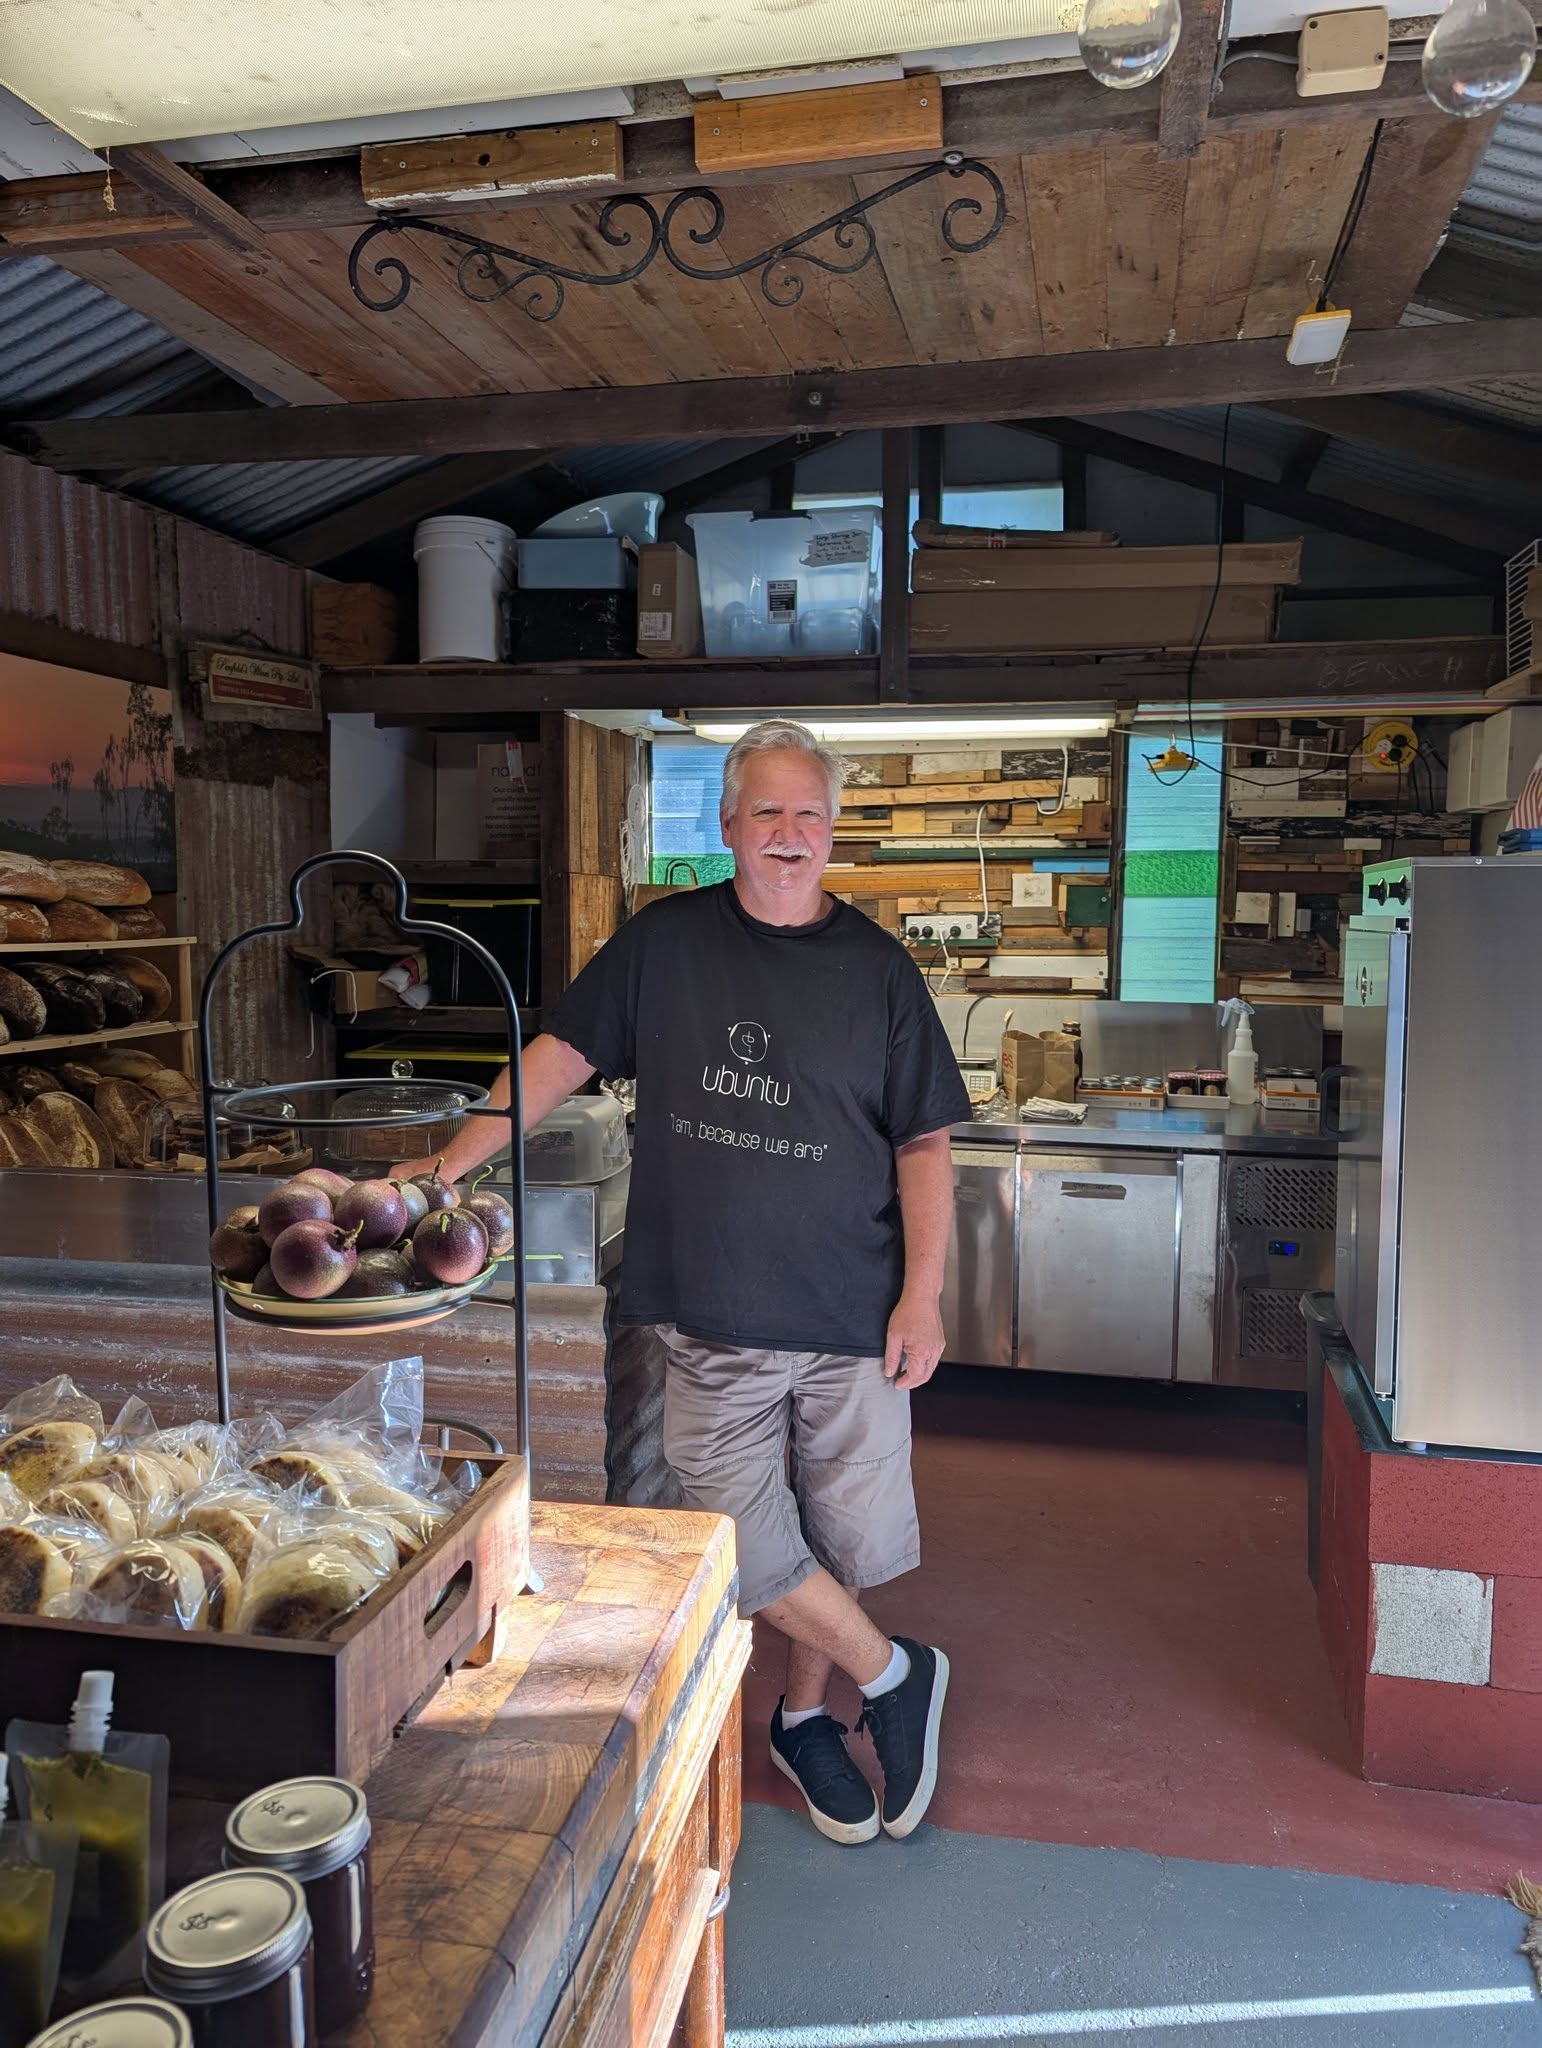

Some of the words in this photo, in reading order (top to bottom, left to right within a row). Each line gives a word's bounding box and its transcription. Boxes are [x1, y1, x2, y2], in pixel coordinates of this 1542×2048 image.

[702, 1064, 791, 1106] ubuntu
[698, 1121, 761, 1150] because
[765, 1136, 789, 1155] we
